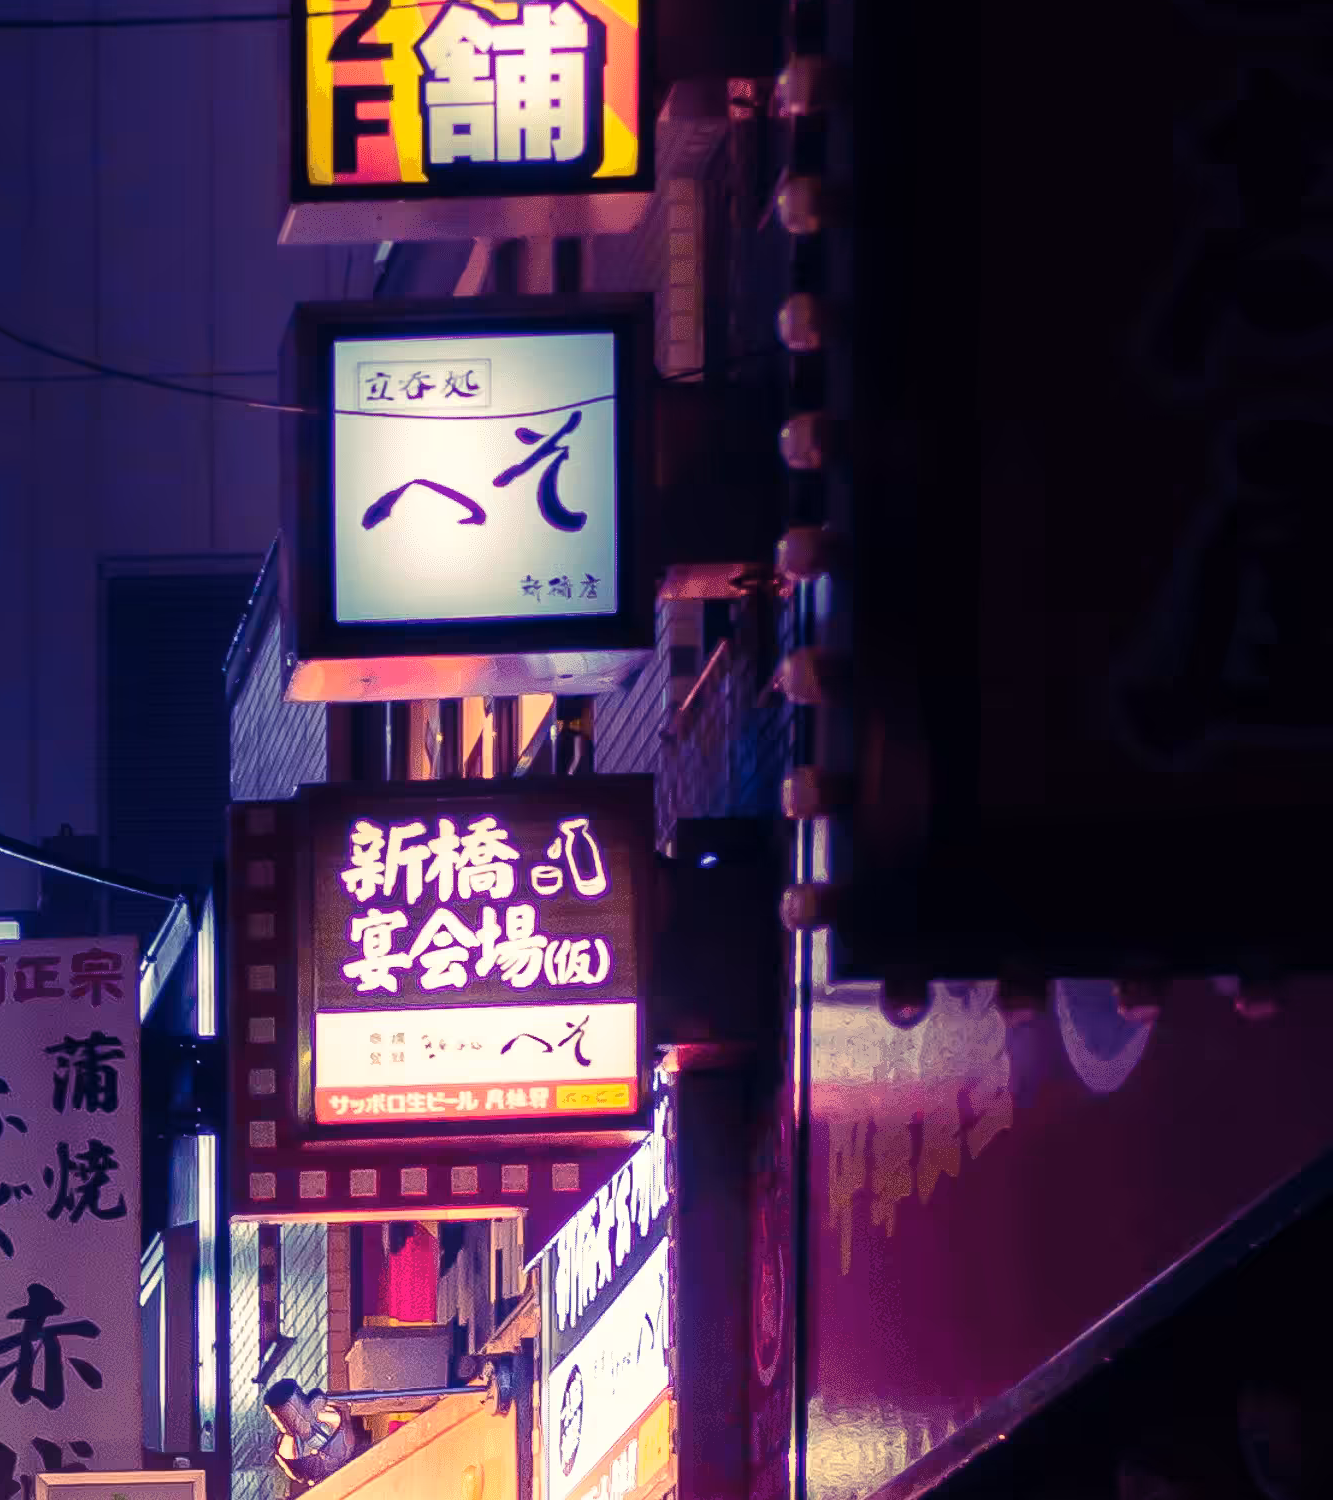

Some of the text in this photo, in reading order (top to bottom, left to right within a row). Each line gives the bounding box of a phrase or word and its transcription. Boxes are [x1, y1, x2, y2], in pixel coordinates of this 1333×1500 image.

[361, 410, 588, 532] へそ
[340, 816, 520, 904] 新橋
[500, 1015, 592, 1067] へそ
[329, 1088, 480, 1116] サッポロ生ビール
